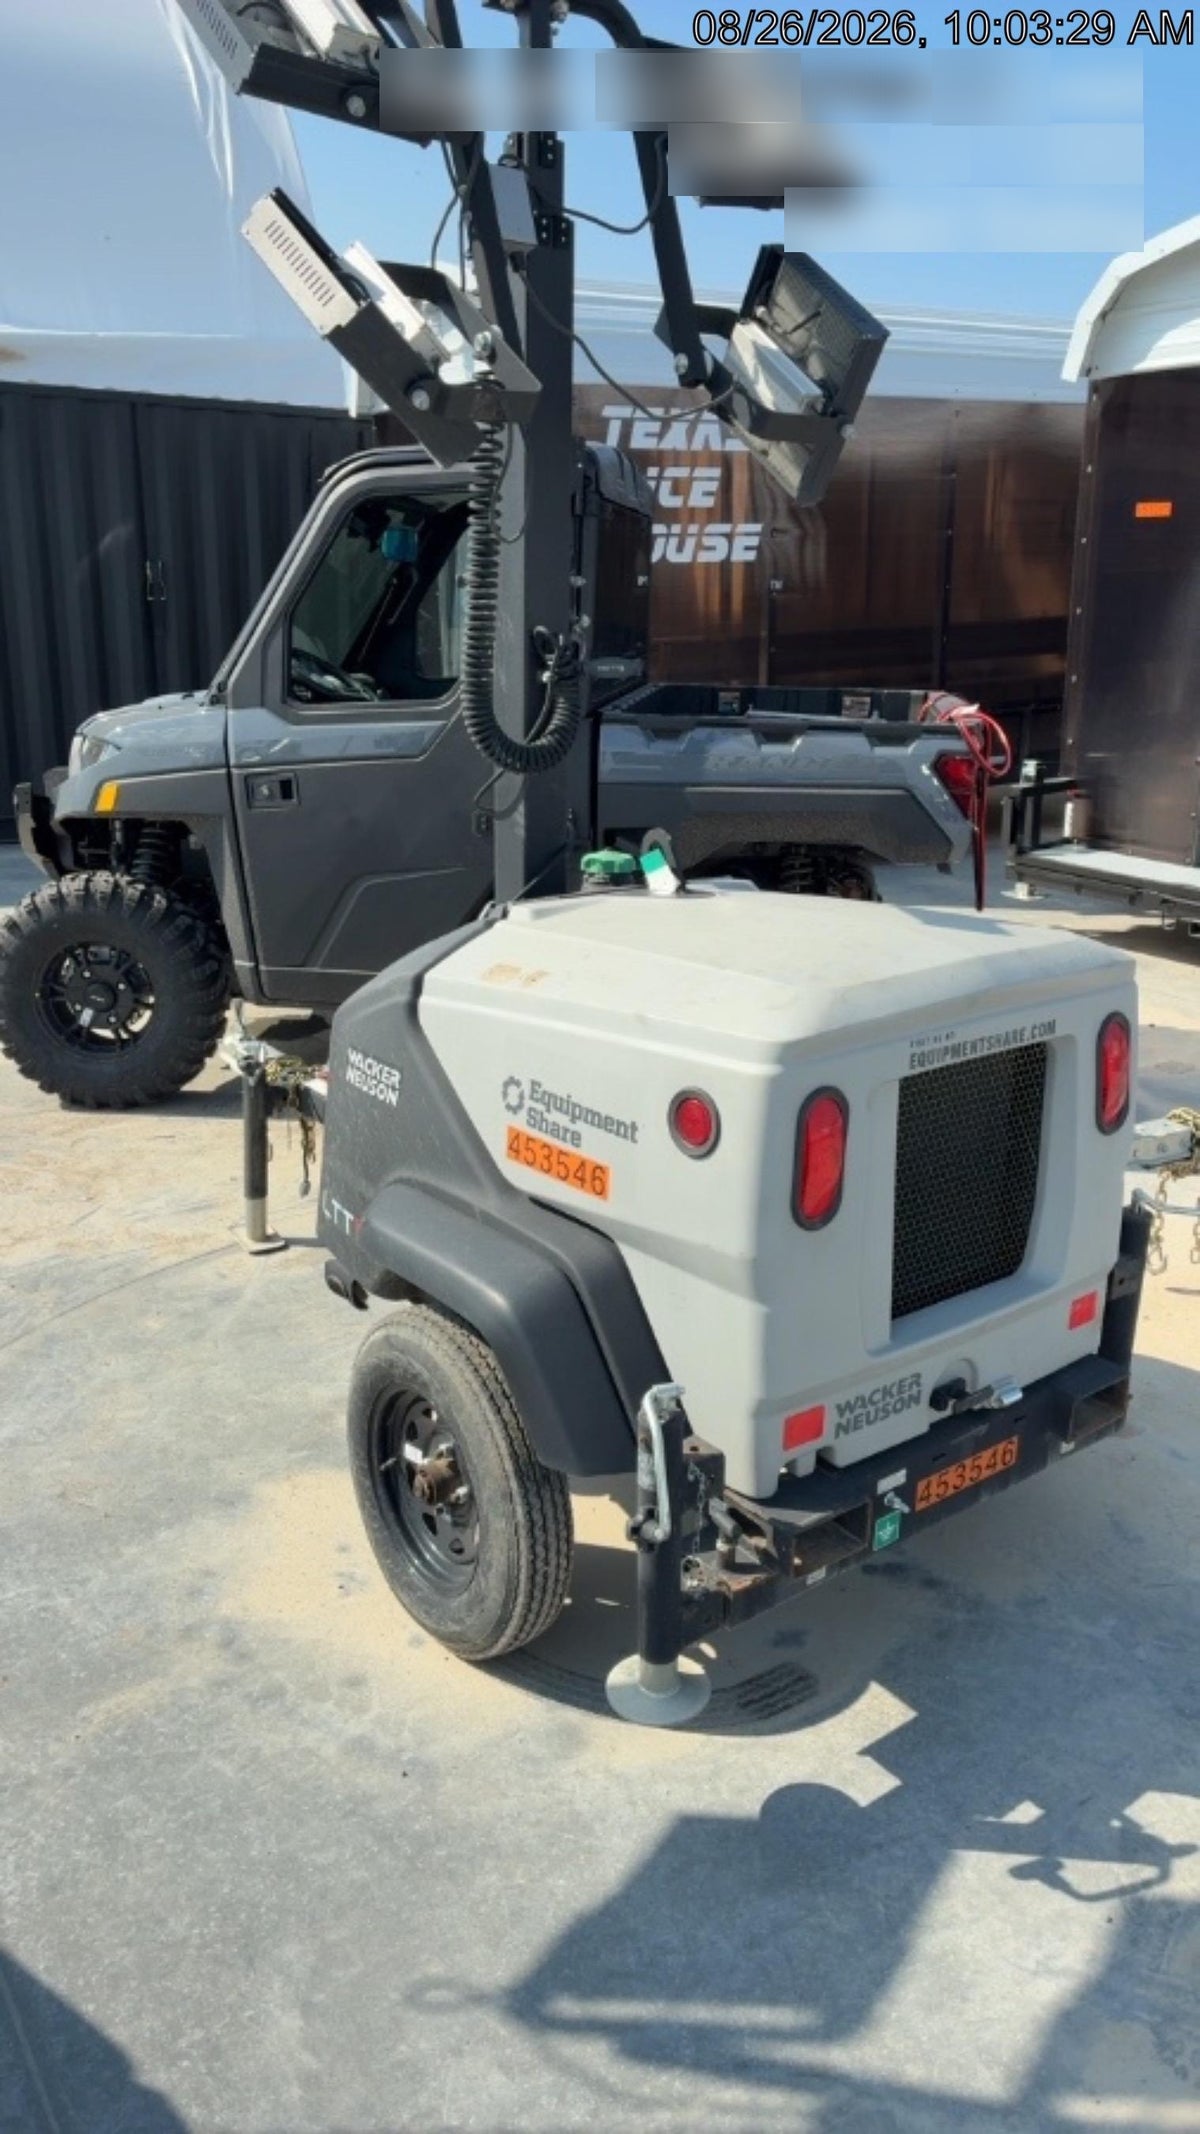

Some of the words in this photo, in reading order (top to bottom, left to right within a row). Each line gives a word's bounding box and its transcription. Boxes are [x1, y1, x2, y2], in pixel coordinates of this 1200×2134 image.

[909, 1019, 1057, 1070] EQUIPMENTSHARE.COM
[525, 1106, 582, 1149] Share
[528, 1079, 639, 1144] Equipment
[506, 1130, 607, 1197] 453546
[833, 1372, 922, 1419] WACKER
[834, 1388, 922, 1440] NEUSON
[919, 1440, 1016, 1504] 453546
